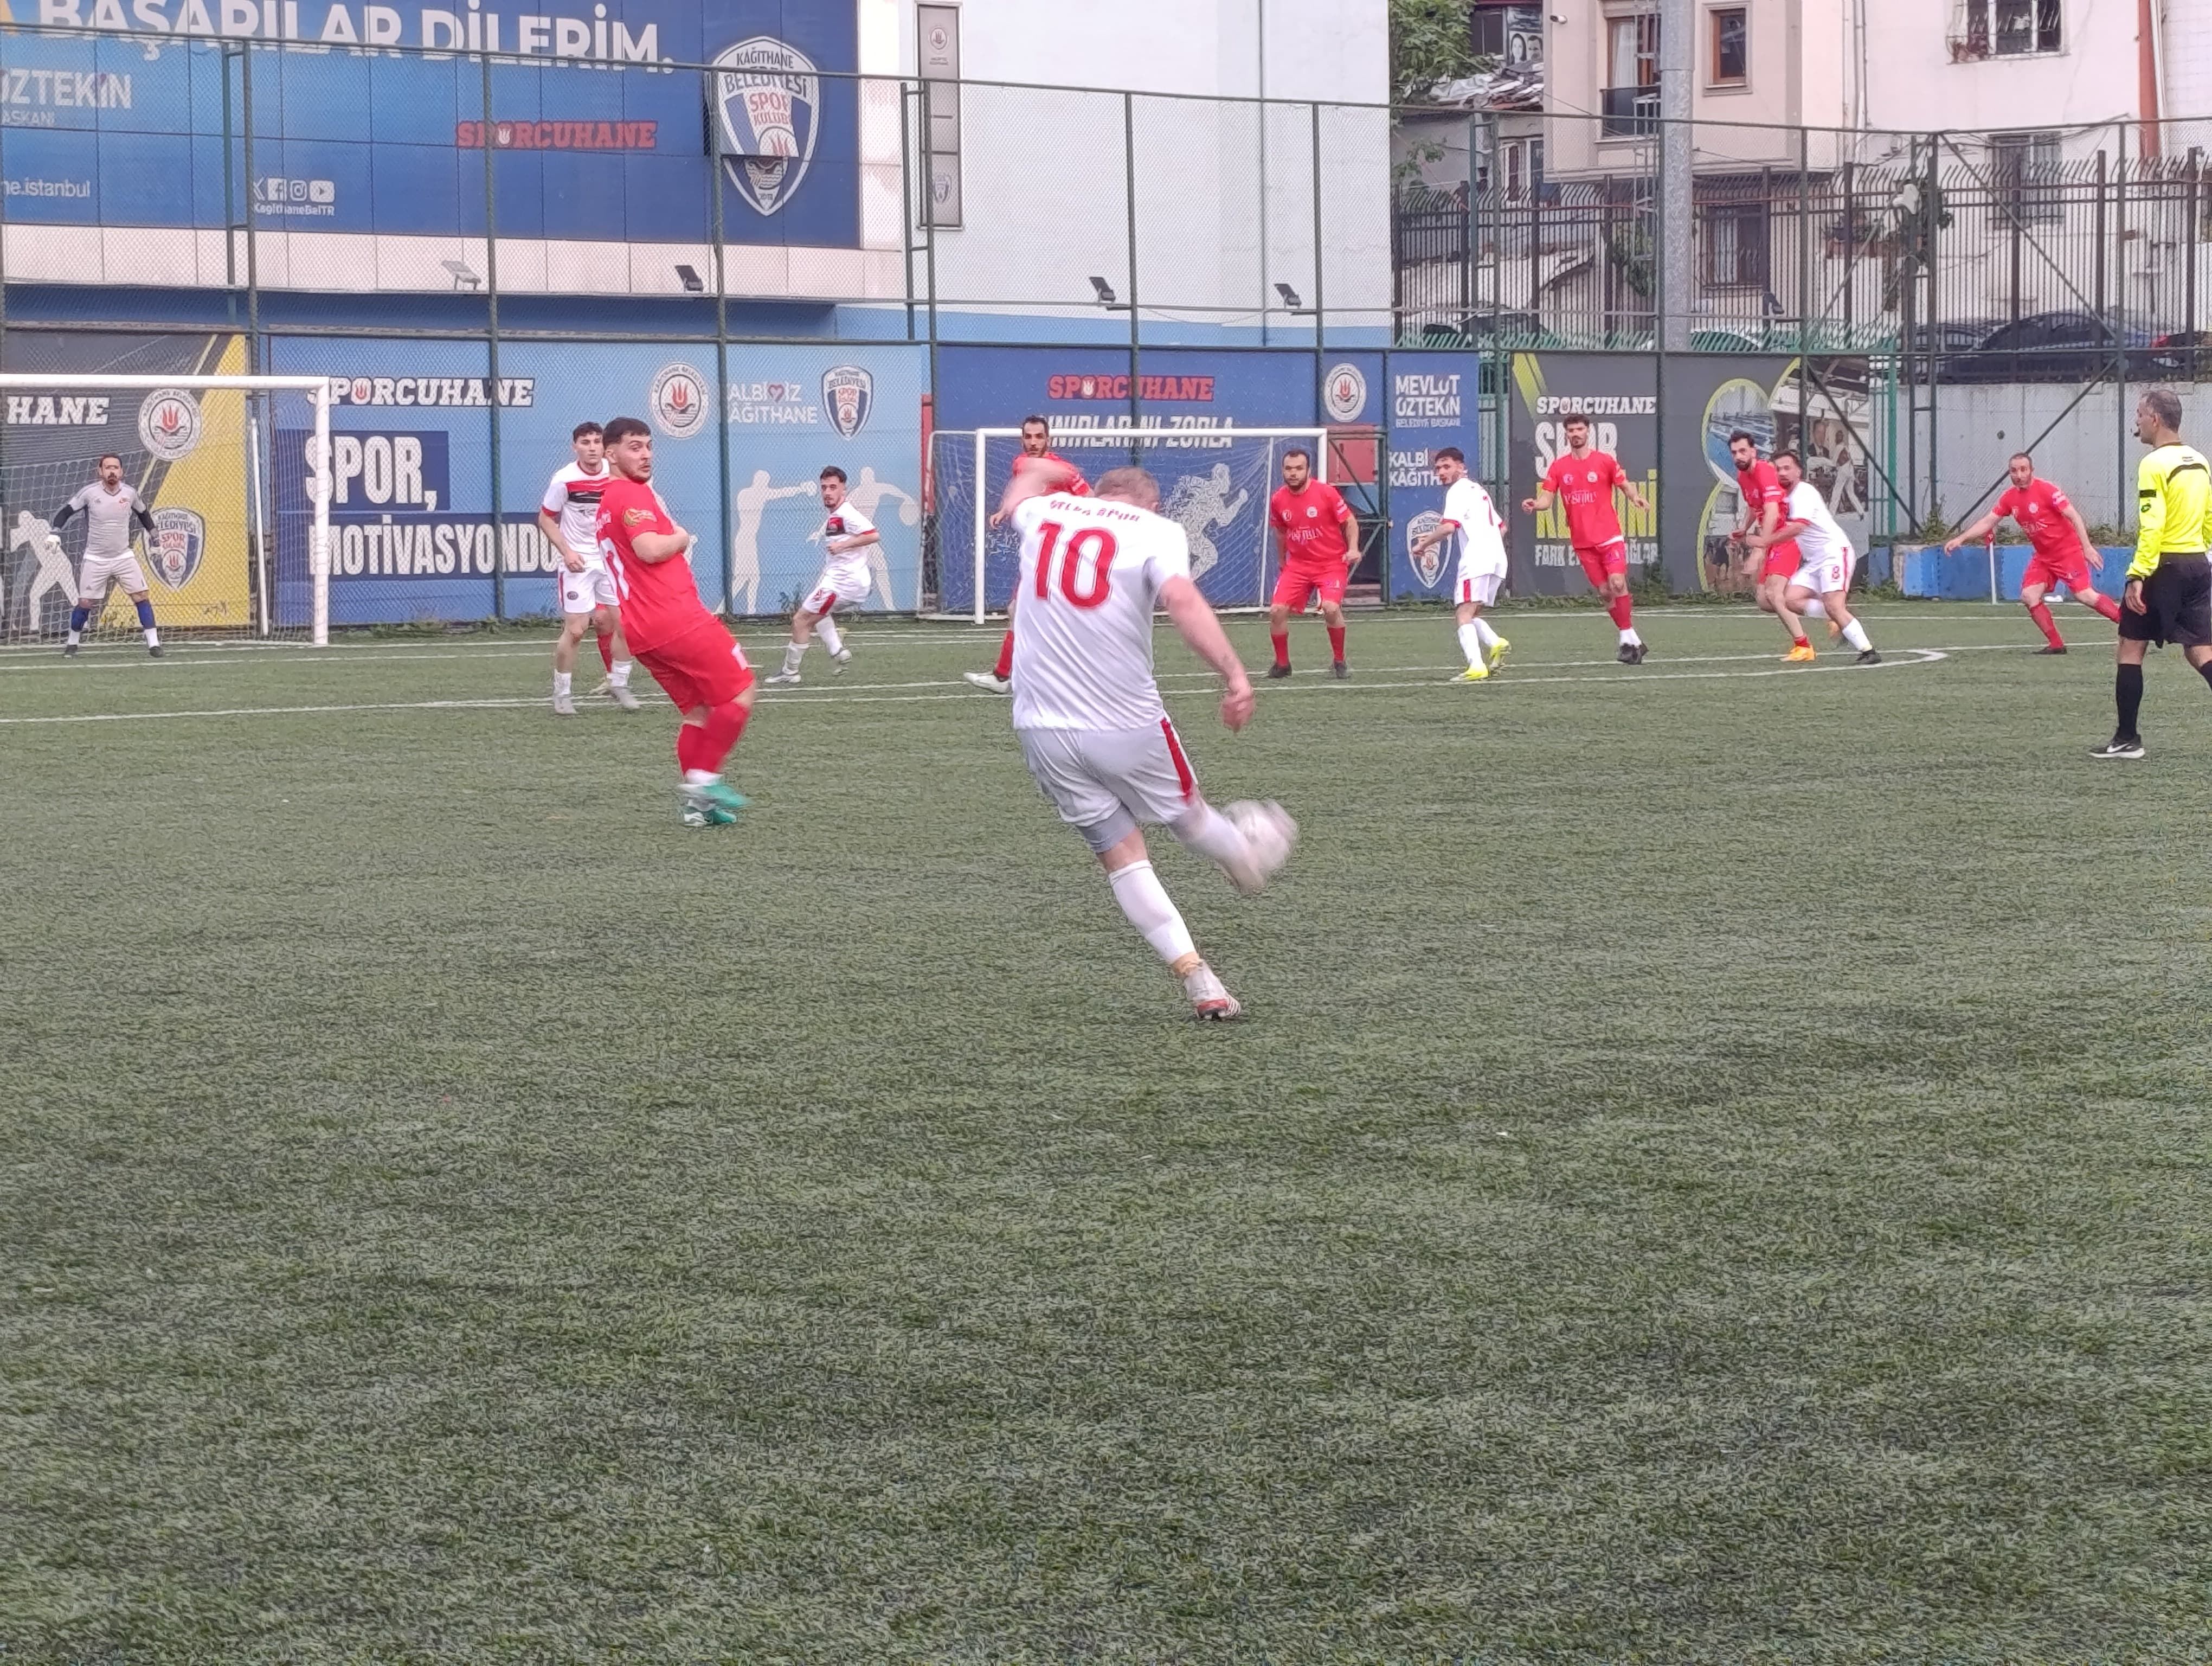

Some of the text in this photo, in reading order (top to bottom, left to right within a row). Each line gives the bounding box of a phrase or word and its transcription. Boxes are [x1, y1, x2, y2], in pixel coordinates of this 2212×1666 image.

[40, 0, 403, 61] BAŞARILAR
[422, 0, 674, 74] DİLERİM.
[7, 395, 110, 425] HANE
[1536, 396, 1656, 414] SPORCUHANE
[1035, 519, 1119, 608] 10
[1832, 566, 1841, 580] 8
